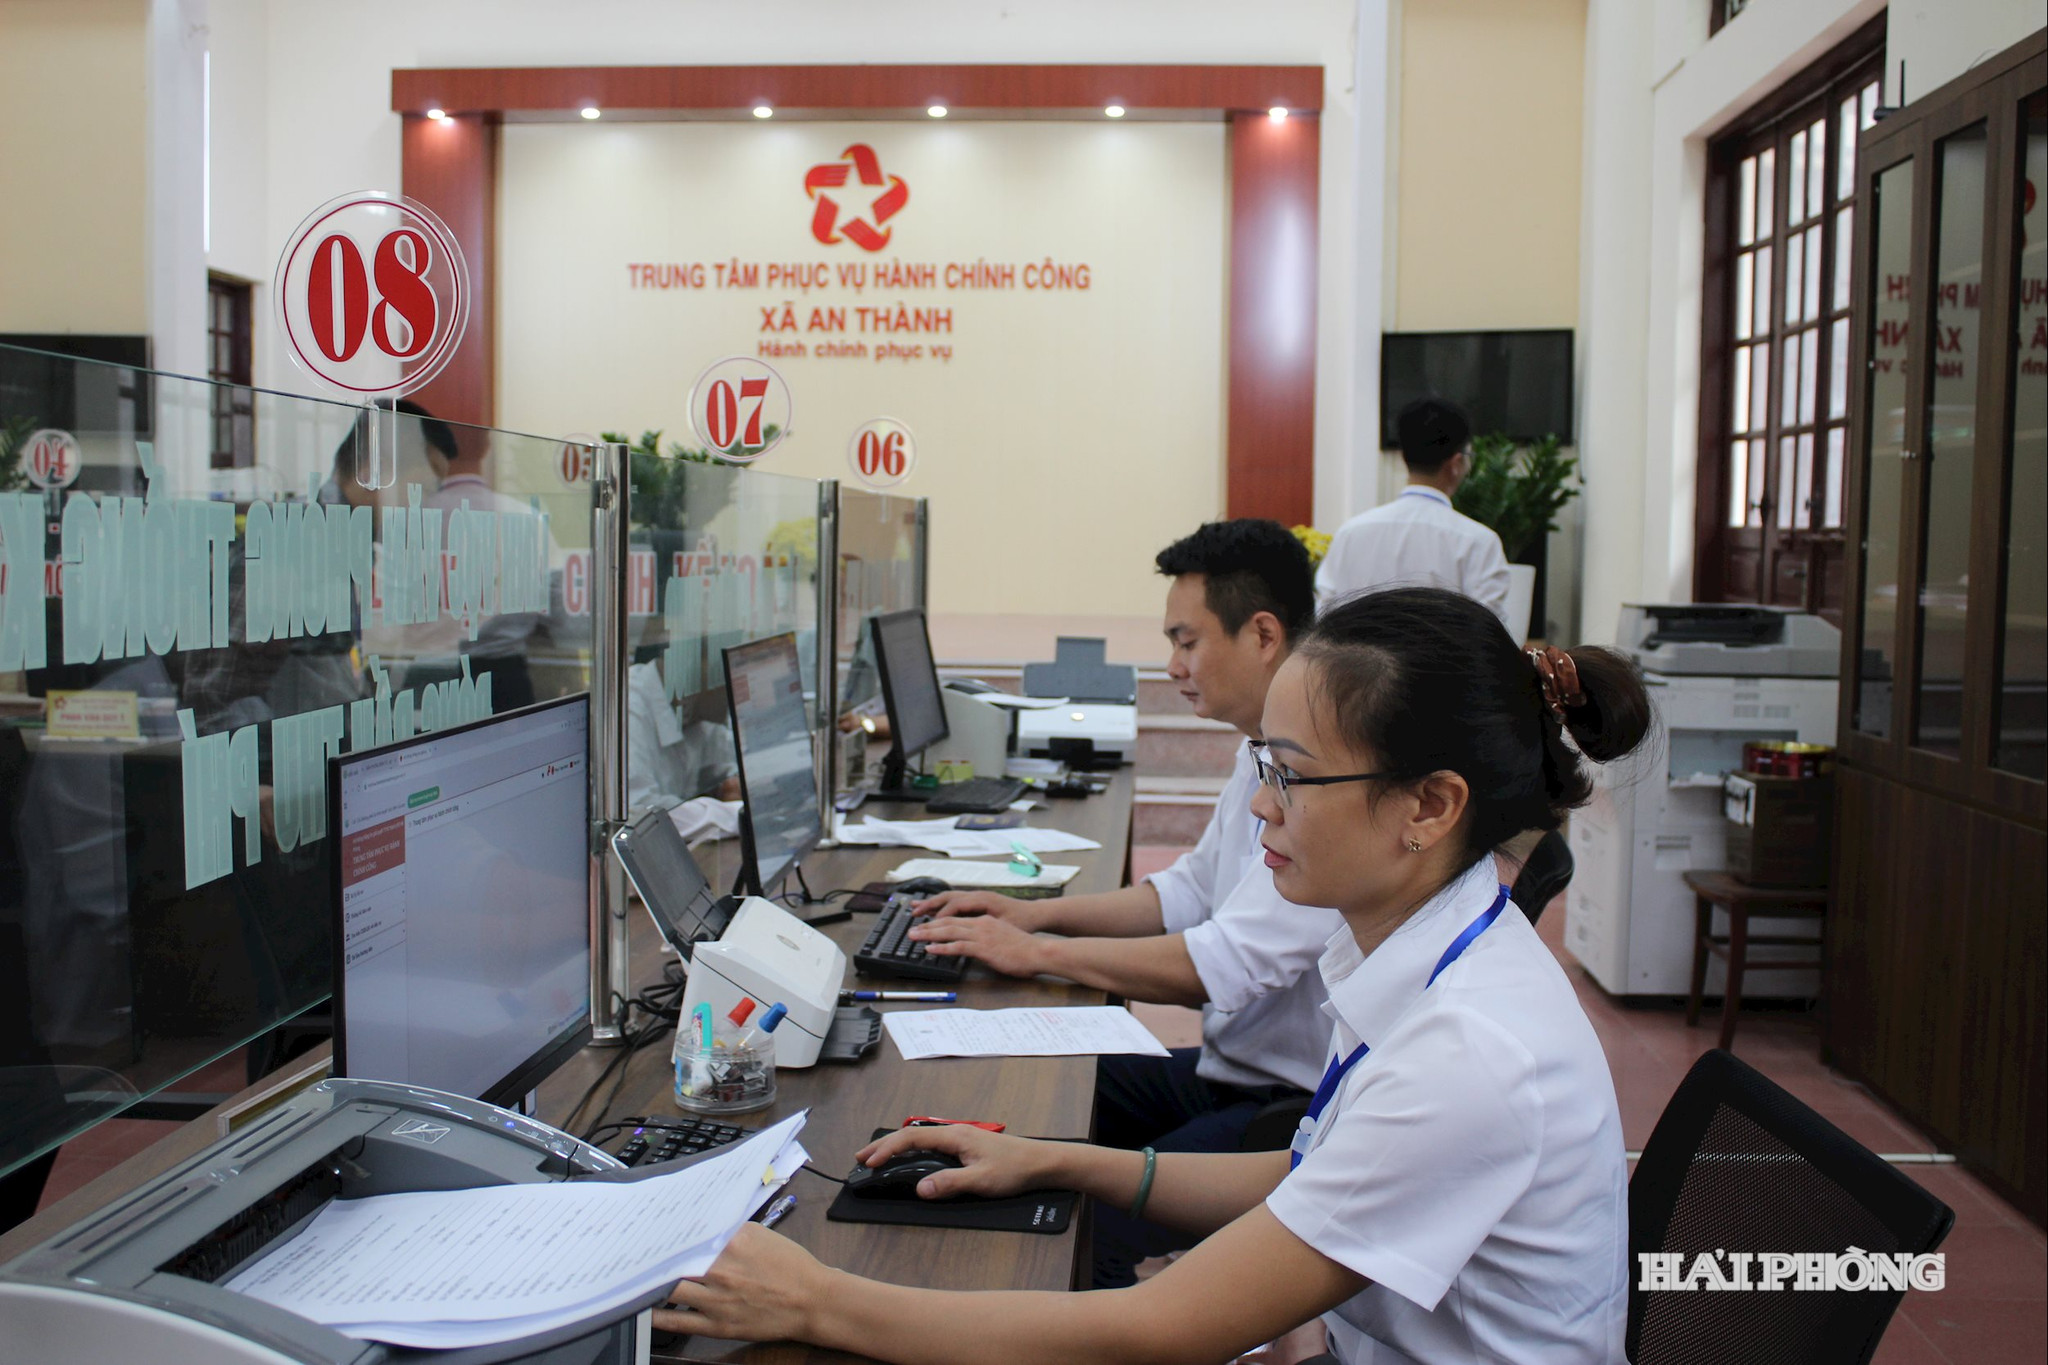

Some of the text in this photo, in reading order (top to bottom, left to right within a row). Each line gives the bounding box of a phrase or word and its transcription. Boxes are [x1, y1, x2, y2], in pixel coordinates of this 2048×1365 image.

[308, 230, 436, 362] 08
[627, 256, 1091, 295] TRUNG TÂM PHỤC VỤ HÀNH CHÍNH CÔNG
[760, 301, 953, 333] XÃ AN THÀNH
[758, 339, 953, 361] Hành chính phục vụ
[706, 376, 769, 448] 07
[858, 429, 905, 476] 06
